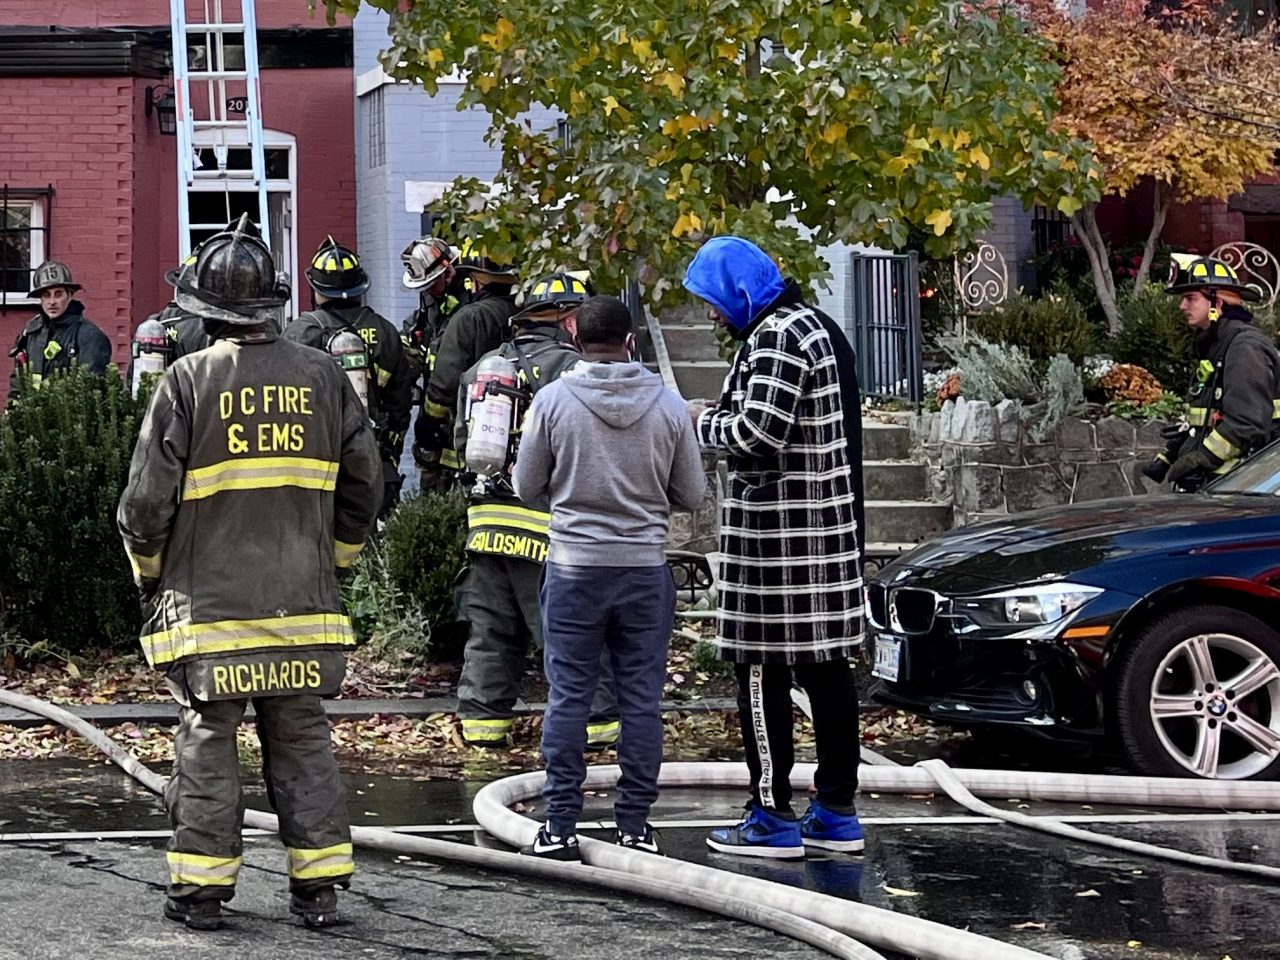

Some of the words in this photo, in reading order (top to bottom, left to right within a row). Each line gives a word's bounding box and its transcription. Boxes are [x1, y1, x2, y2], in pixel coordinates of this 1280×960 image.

[42, 266, 58, 281] 15
[347, 355, 366, 366] T3
[262, 385, 314, 415] FIRE
[227, 423, 249, 454] &
[257, 422, 305, 452] EMS
[468, 531, 551, 562] GOLDSMITH
[213, 660, 321, 695] RICHARDS
[753, 711, 769, 754] G-STAR
